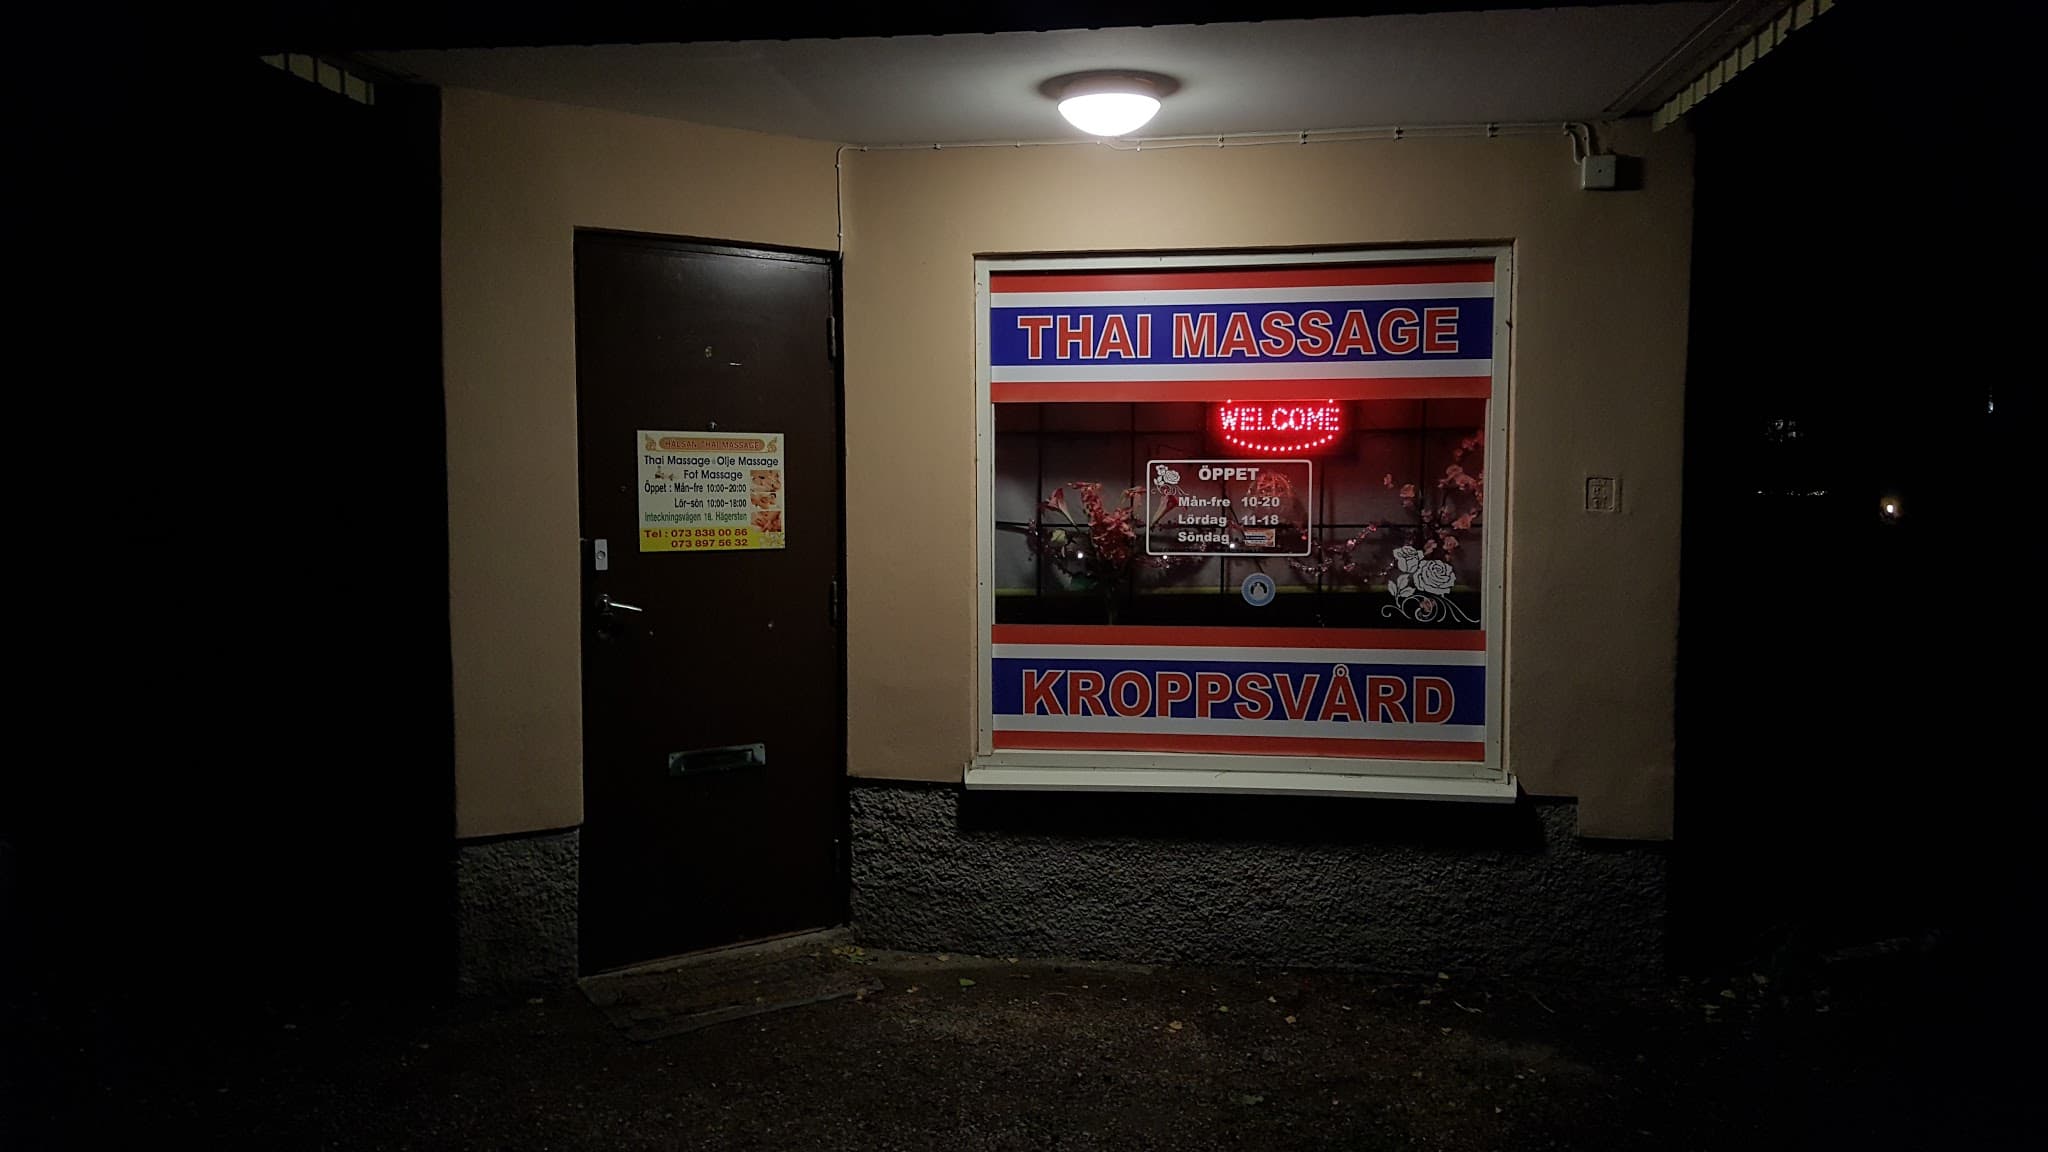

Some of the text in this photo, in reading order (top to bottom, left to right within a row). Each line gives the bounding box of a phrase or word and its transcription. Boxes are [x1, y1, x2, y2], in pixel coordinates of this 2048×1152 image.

[1017, 306, 1460, 360] THAI MASSAGE
[1219, 407, 1341, 431] WELCOME
[722, 440, 760, 449] MASSAGE
[644, 455, 779, 467] Thai Massage Olje Massage
[701, 469, 743, 481] Massage
[1198, 465, 1259, 481] ÖPPET
[644, 480, 666, 494] Öppet
[674, 482, 703, 493] Mån-fre
[707, 483, 747, 493] 10:00-20:00
[674, 498, 747, 508] Lör-sön 10:00-18:00
[1178, 495, 1280, 508] Mån-fre 10-20
[715, 511, 747, 522] Hägersten
[1178, 514, 1279, 526] Lördag 11-18
[643, 529, 662, 538] Tel
[671, 529, 691, 537] 073
[694, 529, 715, 537] 838
[718, 529, 731, 537] 00
[734, 528, 748, 536] 86
[1177, 531, 1230, 544] Söndag
[671, 540, 692, 548] 073
[695, 539, 715, 547] 897
[718, 539, 732, 547] 56
[1021, 663, 1456, 725] KROPPSVÅRD
